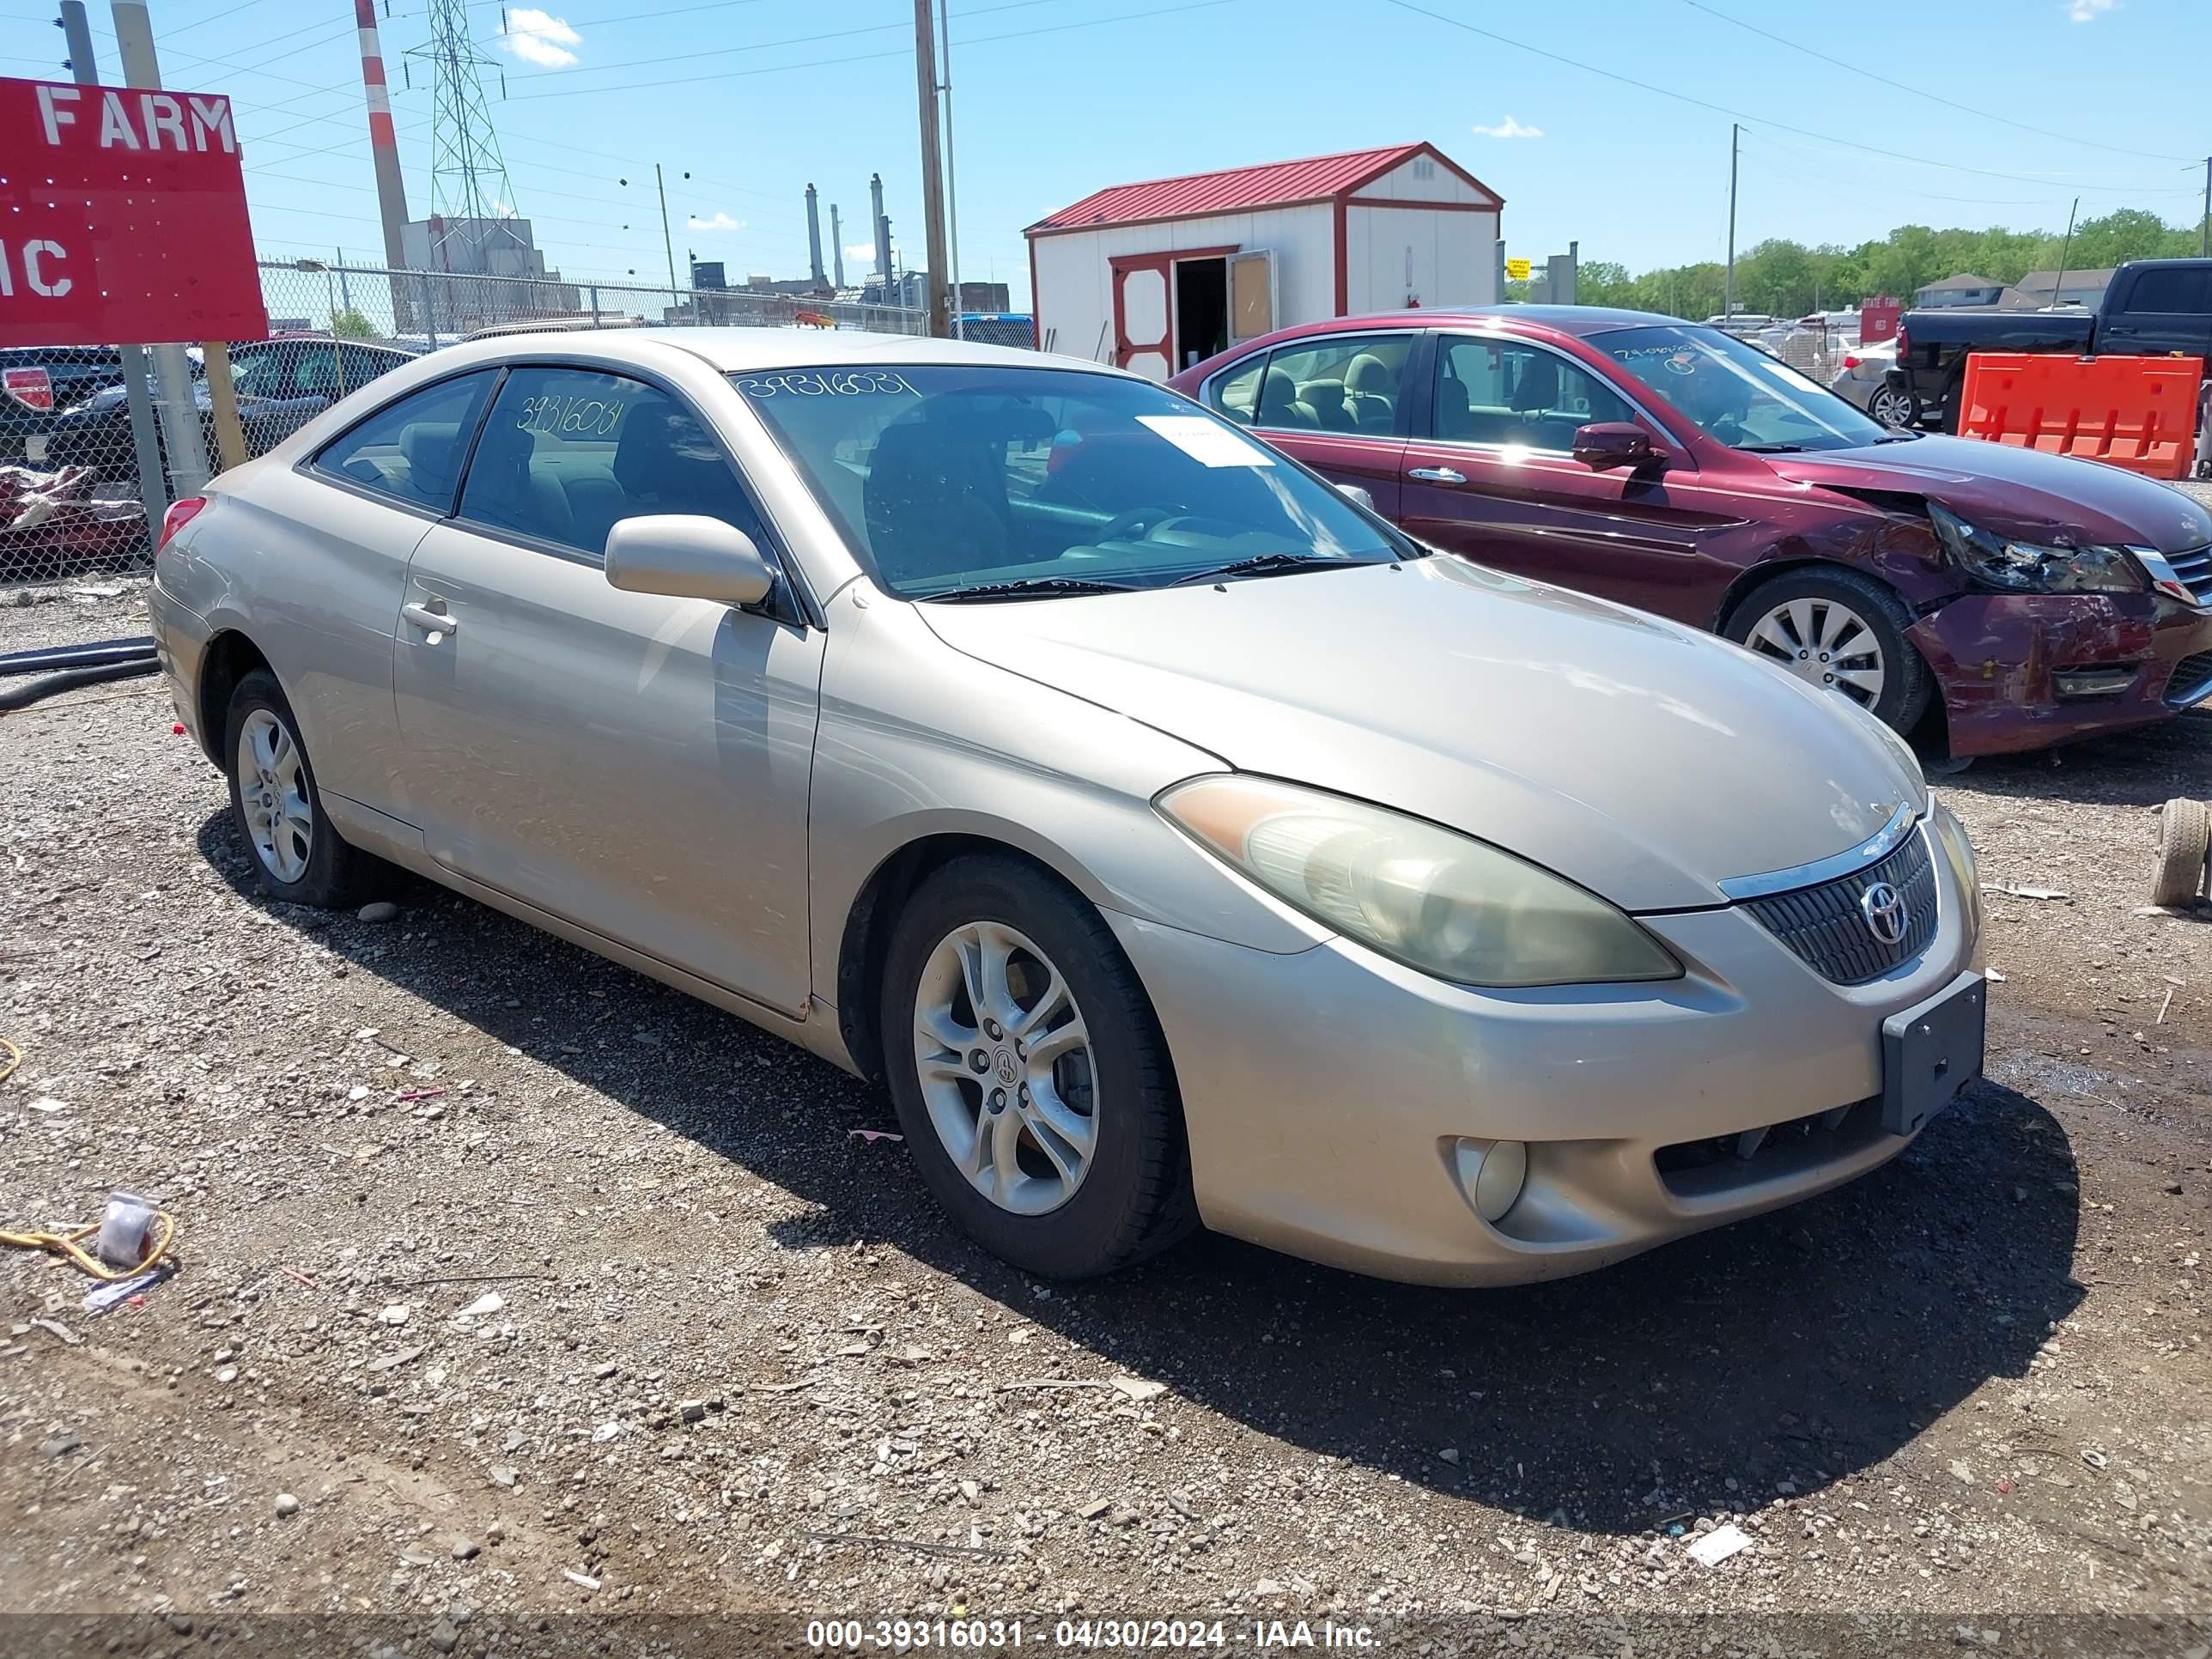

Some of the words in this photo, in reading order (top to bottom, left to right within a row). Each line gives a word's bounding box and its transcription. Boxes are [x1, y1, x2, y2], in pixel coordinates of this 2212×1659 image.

[35, 85, 234, 154] FARM
[736, 372, 923, 398] 39316031
[516, 394, 624, 435] 39316031
